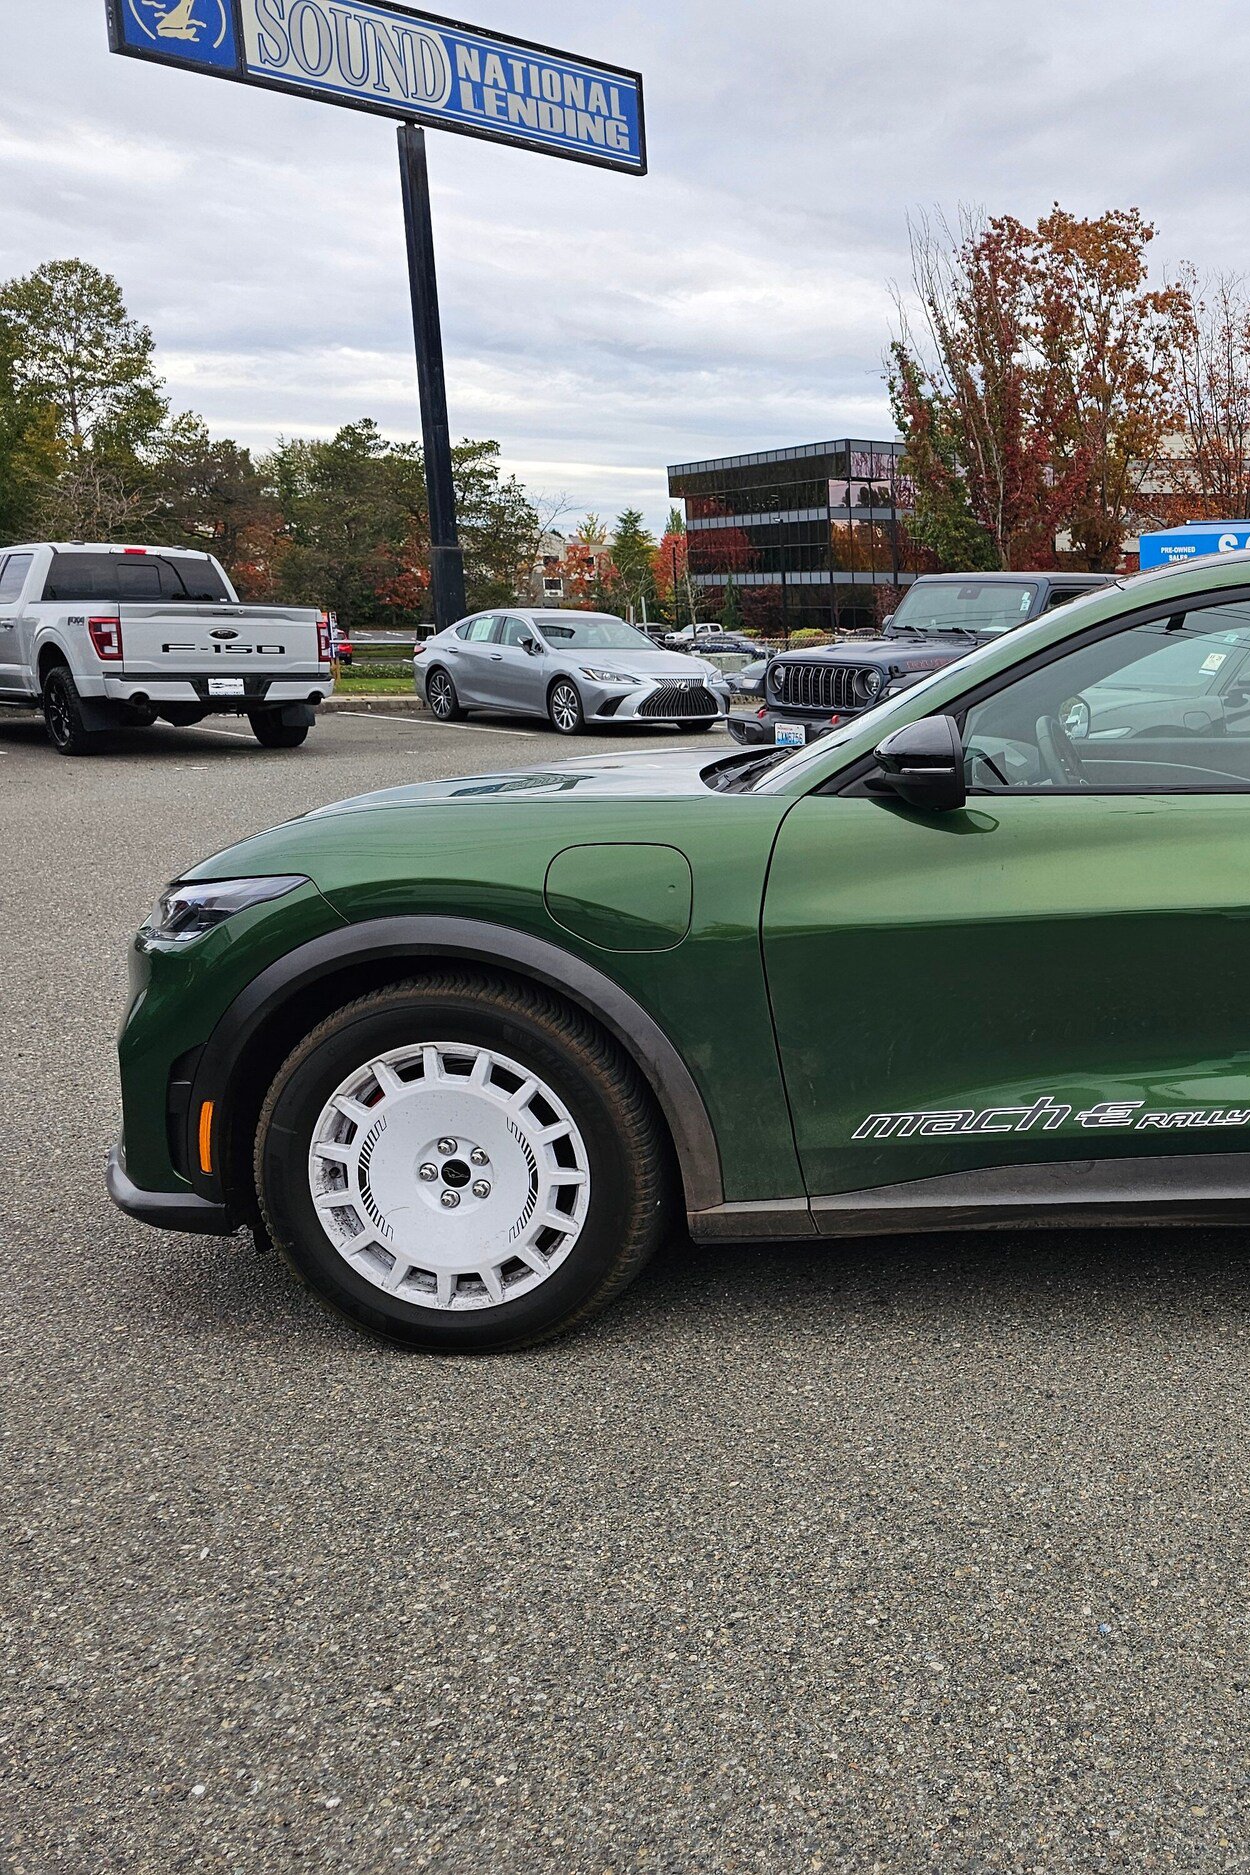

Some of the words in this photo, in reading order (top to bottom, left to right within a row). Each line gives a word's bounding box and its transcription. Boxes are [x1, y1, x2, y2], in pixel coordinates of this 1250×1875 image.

[257, 0, 446, 102] SOUND
[457, 45, 626, 121] NATIONAL
[460, 79, 630, 151] LENDING
[1160, 546, 1196, 554] PRE-OWNED
[161, 643, 286, 655] F-150
